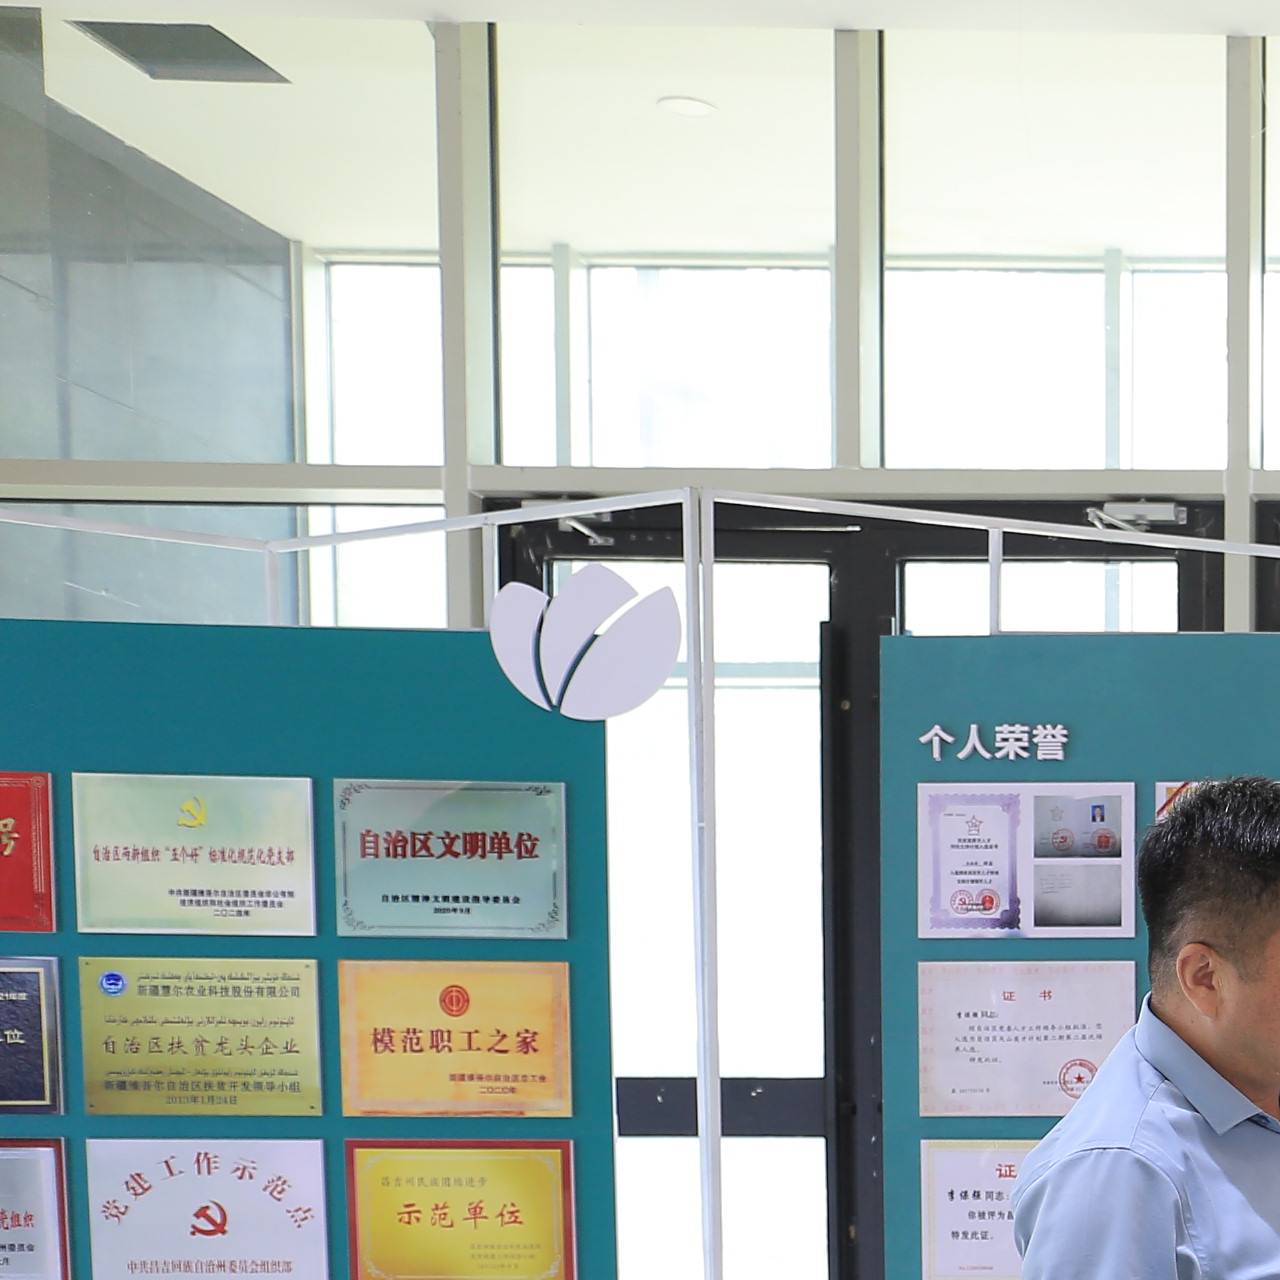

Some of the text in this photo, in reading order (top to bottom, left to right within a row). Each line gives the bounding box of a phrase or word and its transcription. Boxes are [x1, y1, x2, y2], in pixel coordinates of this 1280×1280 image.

[918, 723, 1069, 762] 个人荣誉
[359, 829, 541, 861] 自治区文明单位
[1002, 990, 1053, 1002] 证书
[0, 1028, 26, 1045] 位
[102, 1034, 301, 1057] 自治区扶贫龙头企业
[370, 1027, 540, 1055] 模范职工之家
[995, 1163, 1018, 1179] 证
[102, 1151, 315, 1230] 党建工作示范点
[396, 1199, 524, 1230] 示范单位
[127, 1259, 293, 1275] 中共昌吉回族自治州委员会组织部
